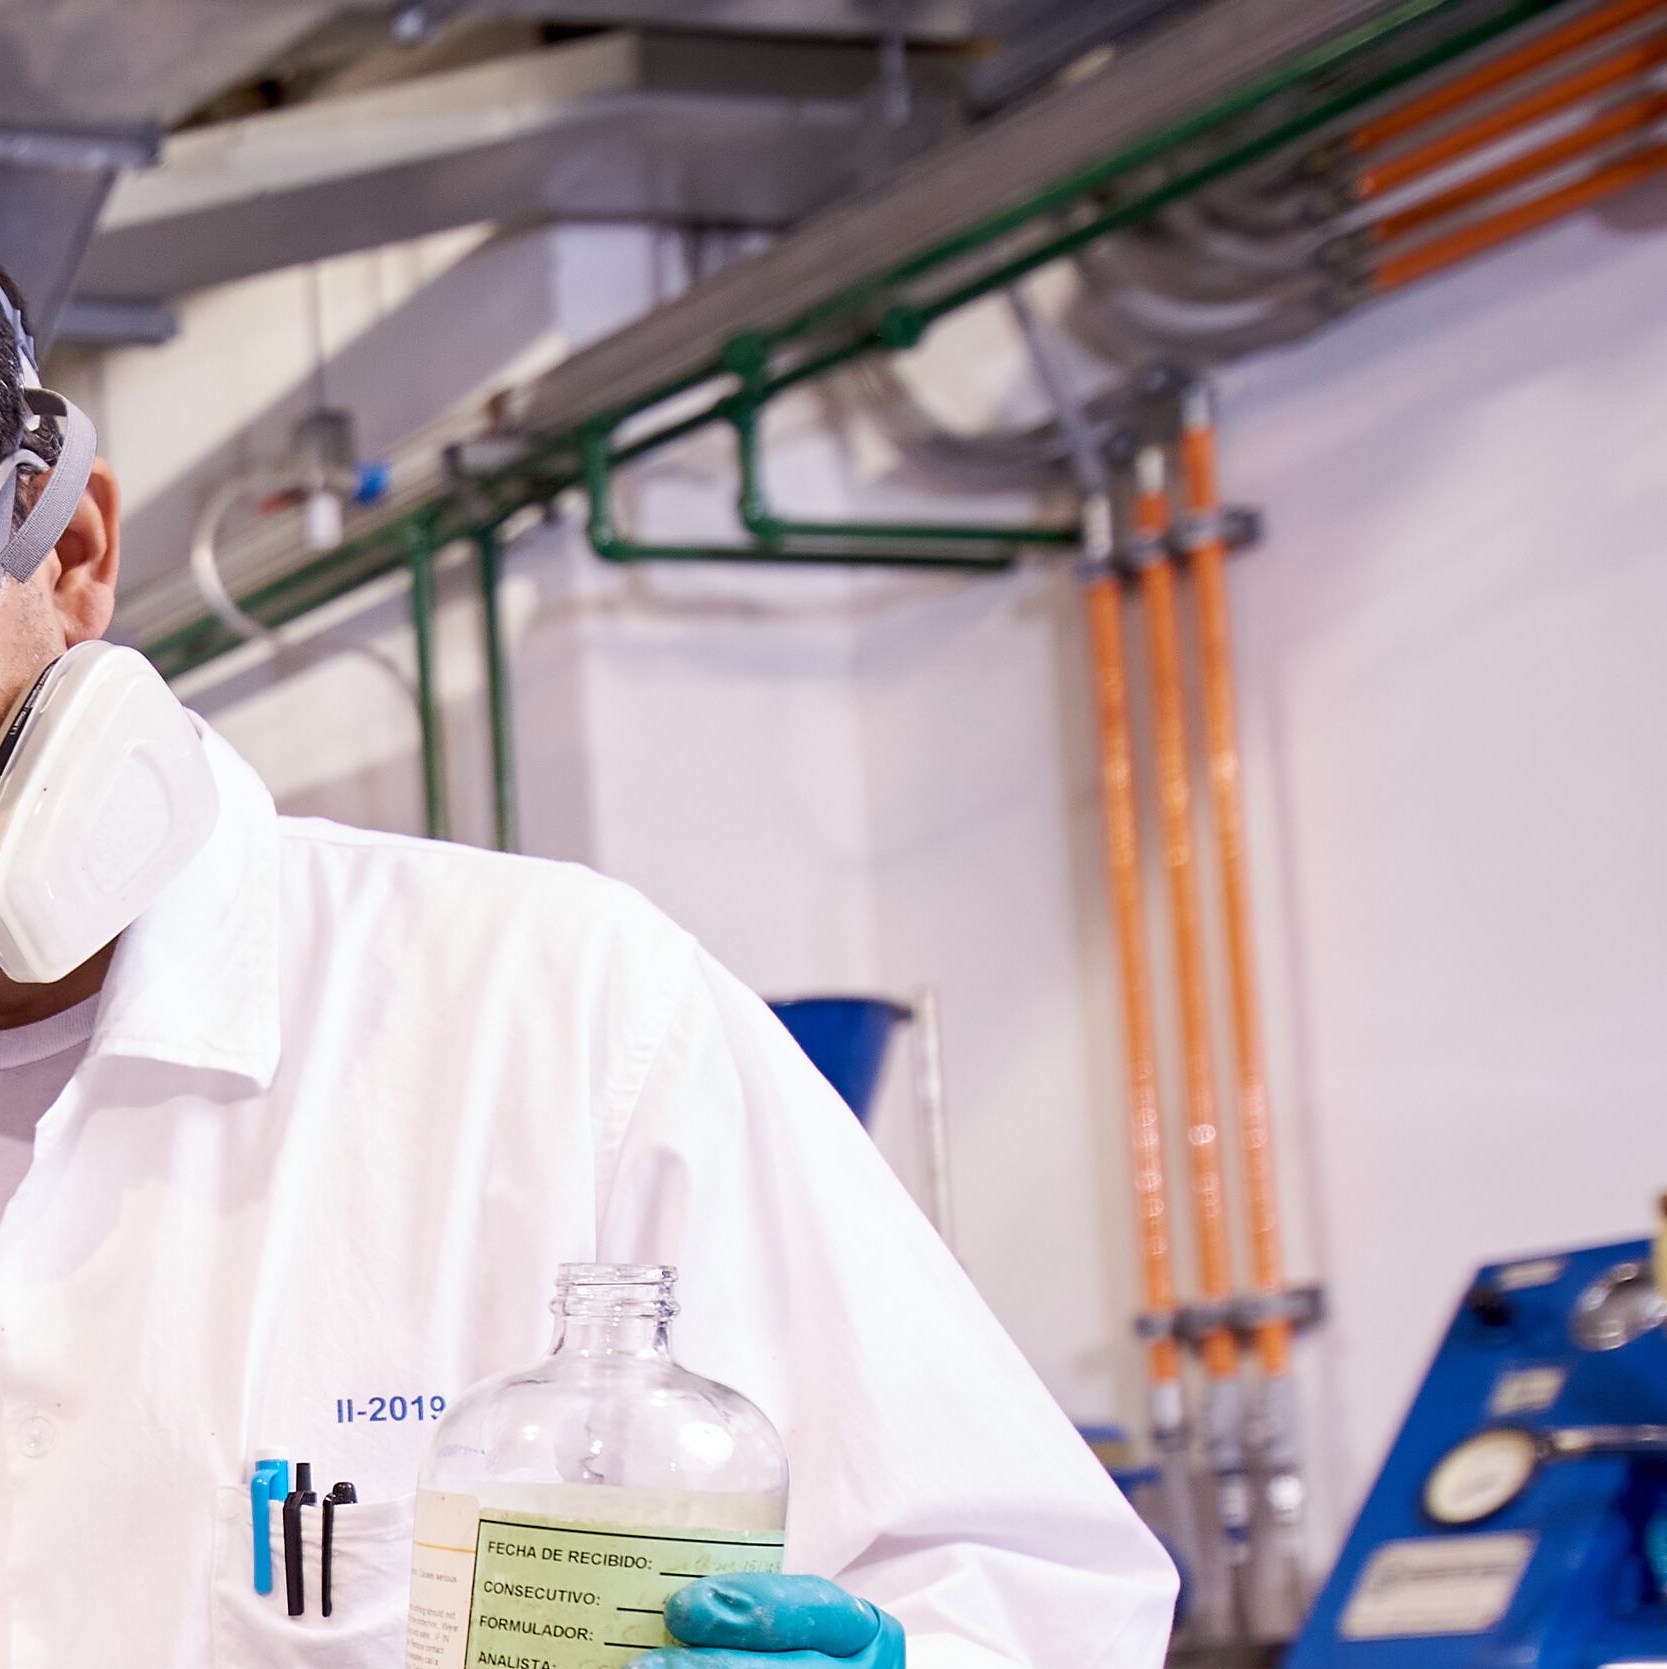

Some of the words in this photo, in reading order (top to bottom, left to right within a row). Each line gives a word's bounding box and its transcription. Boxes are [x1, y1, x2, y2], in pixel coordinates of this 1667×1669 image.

[337, 1395, 446, 1423] II-2019
[487, 1541, 537, 1560] FECHA
[542, 1547, 563, 1562] DE
[568, 1549, 653, 1570] RECIBIDO:
[483, 1581, 601, 1606] CONSECUTIVO:
[479, 1616, 593, 1642] FORMULADOR:
